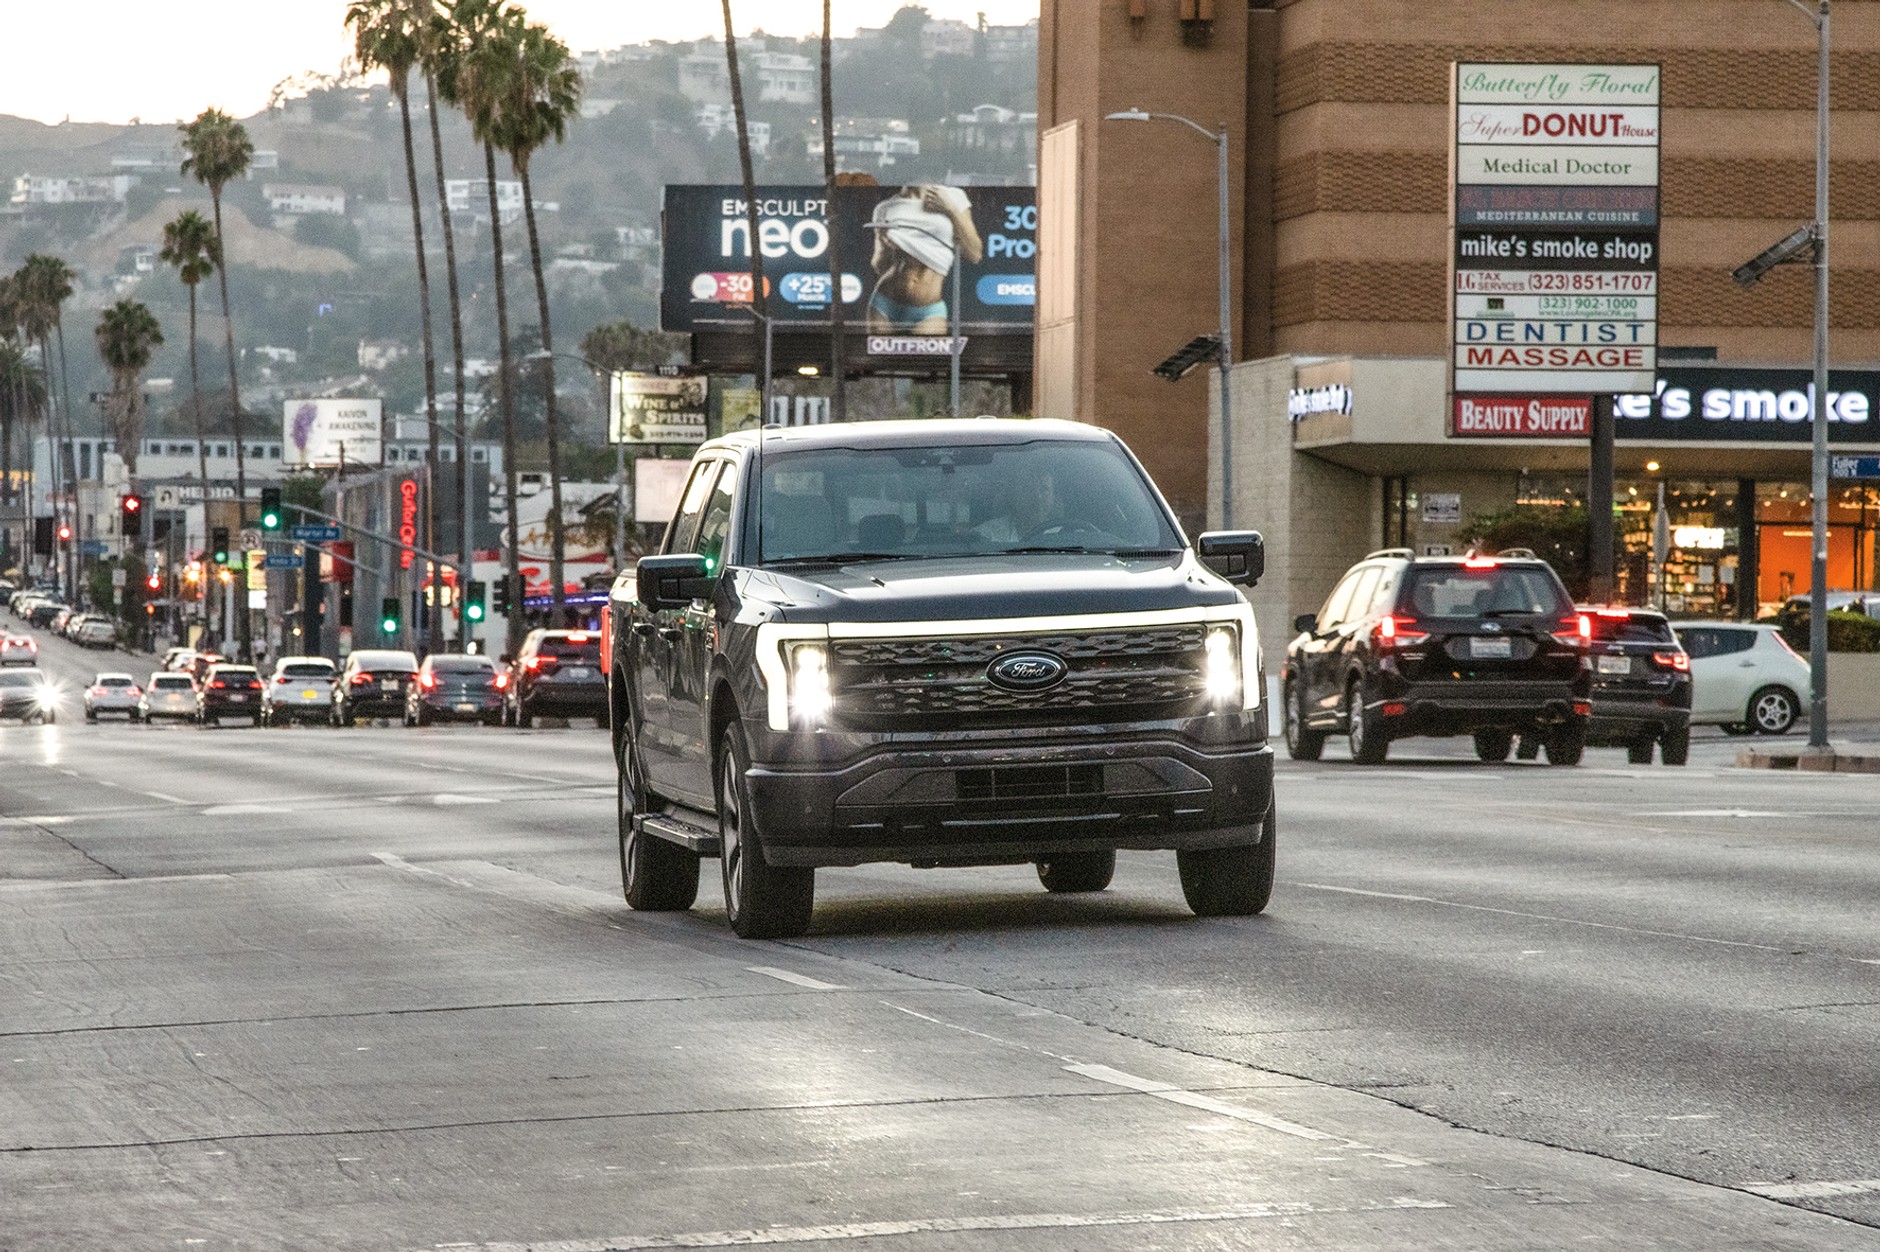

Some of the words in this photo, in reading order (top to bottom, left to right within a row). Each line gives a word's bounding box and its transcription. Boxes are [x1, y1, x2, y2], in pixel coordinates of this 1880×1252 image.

[1463, 72, 1570, 100] Butterfly
[1580, 73, 1655, 95] Floral
[1459, 112, 1523, 141] Super
[1522, 113, 1624, 137] DONUT
[1621, 124, 1656, 137] House
[1483, 159, 1558, 174] Medical
[1566, 159, 1631, 174] Doctor
[722, 199, 829, 216] EMSCULPT
[1476, 211, 1583, 222] MEDITERRANEAN
[1588, 211, 1640, 222] CUISINE
[721, 218, 829, 258] neo
[987, 233, 1036, 258] Pro
[1461, 235, 1527, 257] mike's
[1532, 238, 1598, 258] smoke
[1603, 238, 1652, 263] shop
[1479, 272, 1500, 281] TAX
[1528, 275, 1569, 290] (323)
[1573, 275, 1652, 291] 851-1707
[1478, 282, 1525, 291] SERVICES
[1538, 297, 1571, 309] (323)
[1575, 298, 1637, 309] 902-1000
[1466, 322, 1644, 342] DENTIST
[1467, 348, 1643, 367] MASSAGE
[1613, 379, 1691, 418] e's
[1702, 382, 1869, 423] smoke
[1461, 400, 1523, 430] BEAUTY
[1527, 401, 1587, 430] SUPPLY
[1011, 662, 1046, 677] Ford
